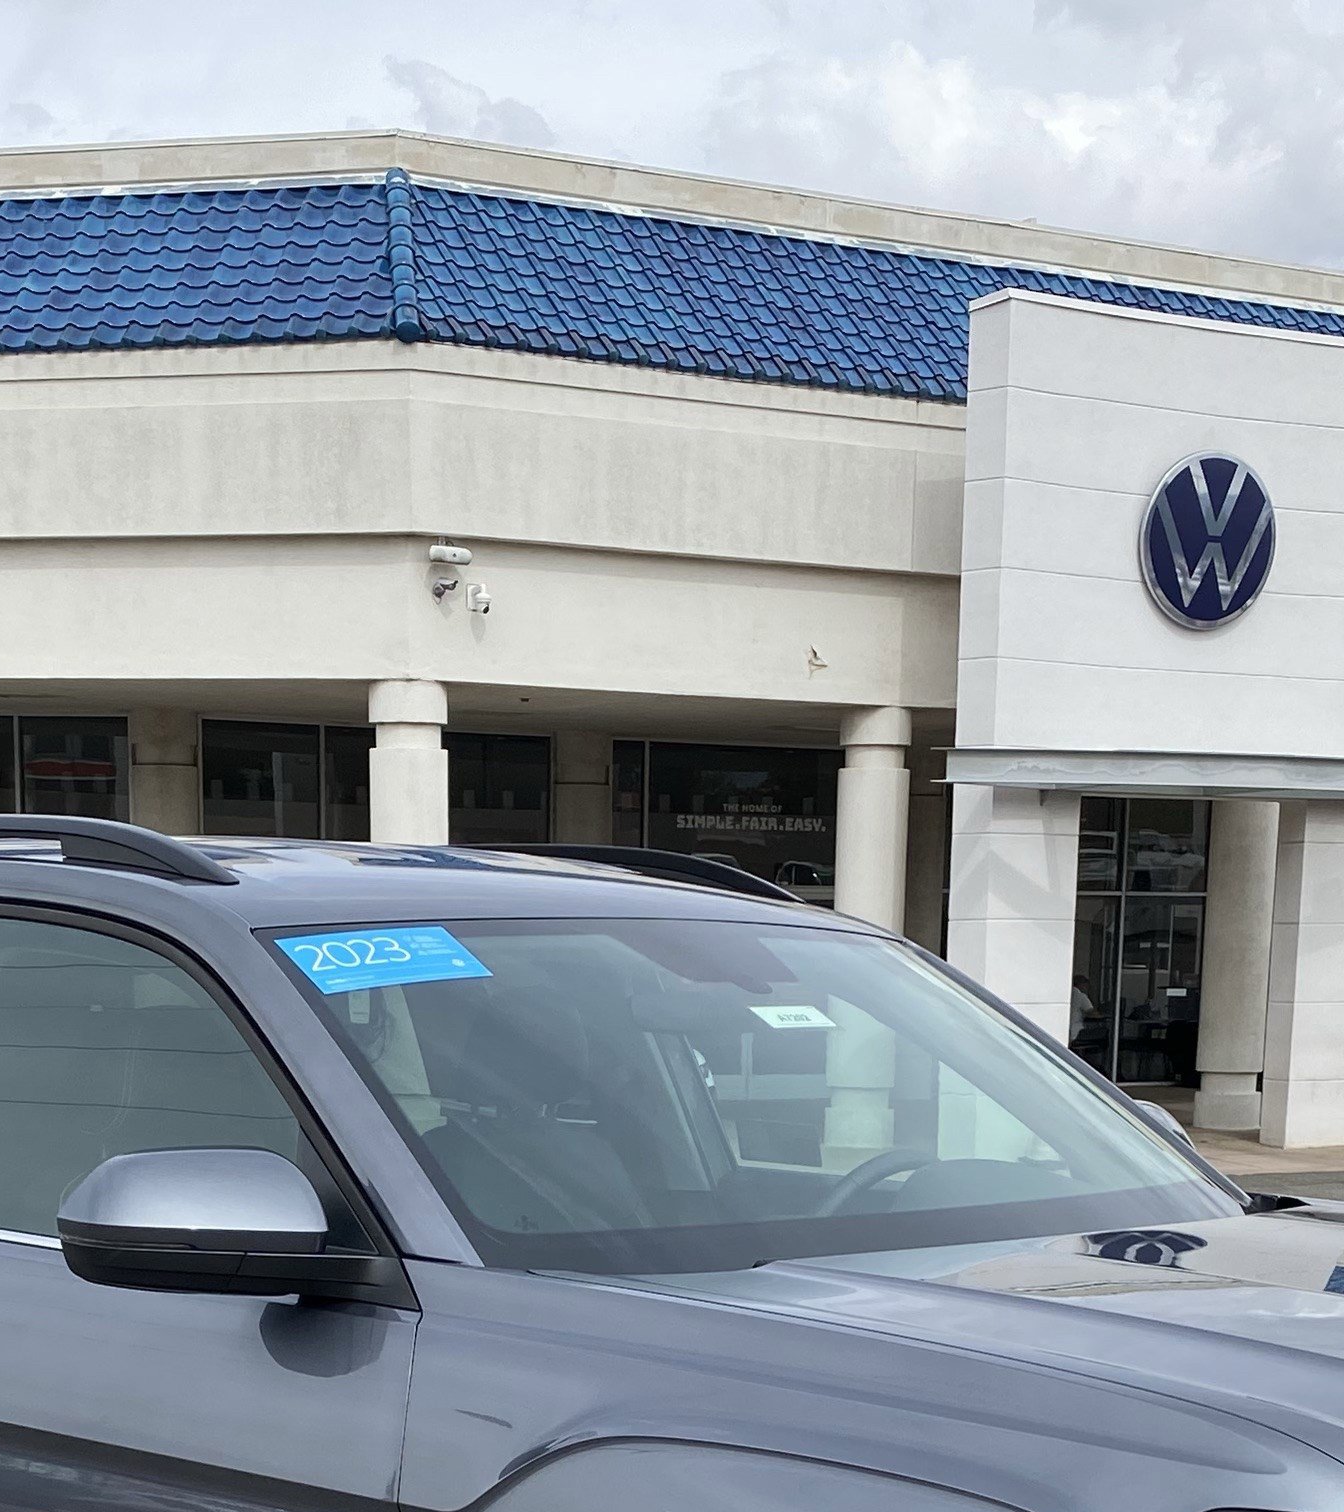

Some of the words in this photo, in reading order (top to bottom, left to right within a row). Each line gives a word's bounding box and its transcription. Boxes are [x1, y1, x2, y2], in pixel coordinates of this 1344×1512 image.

[1146, 454, 1275, 622] VW
[723, 803, 740, 813] THE
[741, 803, 769, 813] HOME
[770, 804, 783, 813] OF
[293, 936, 412, 972] 2023
